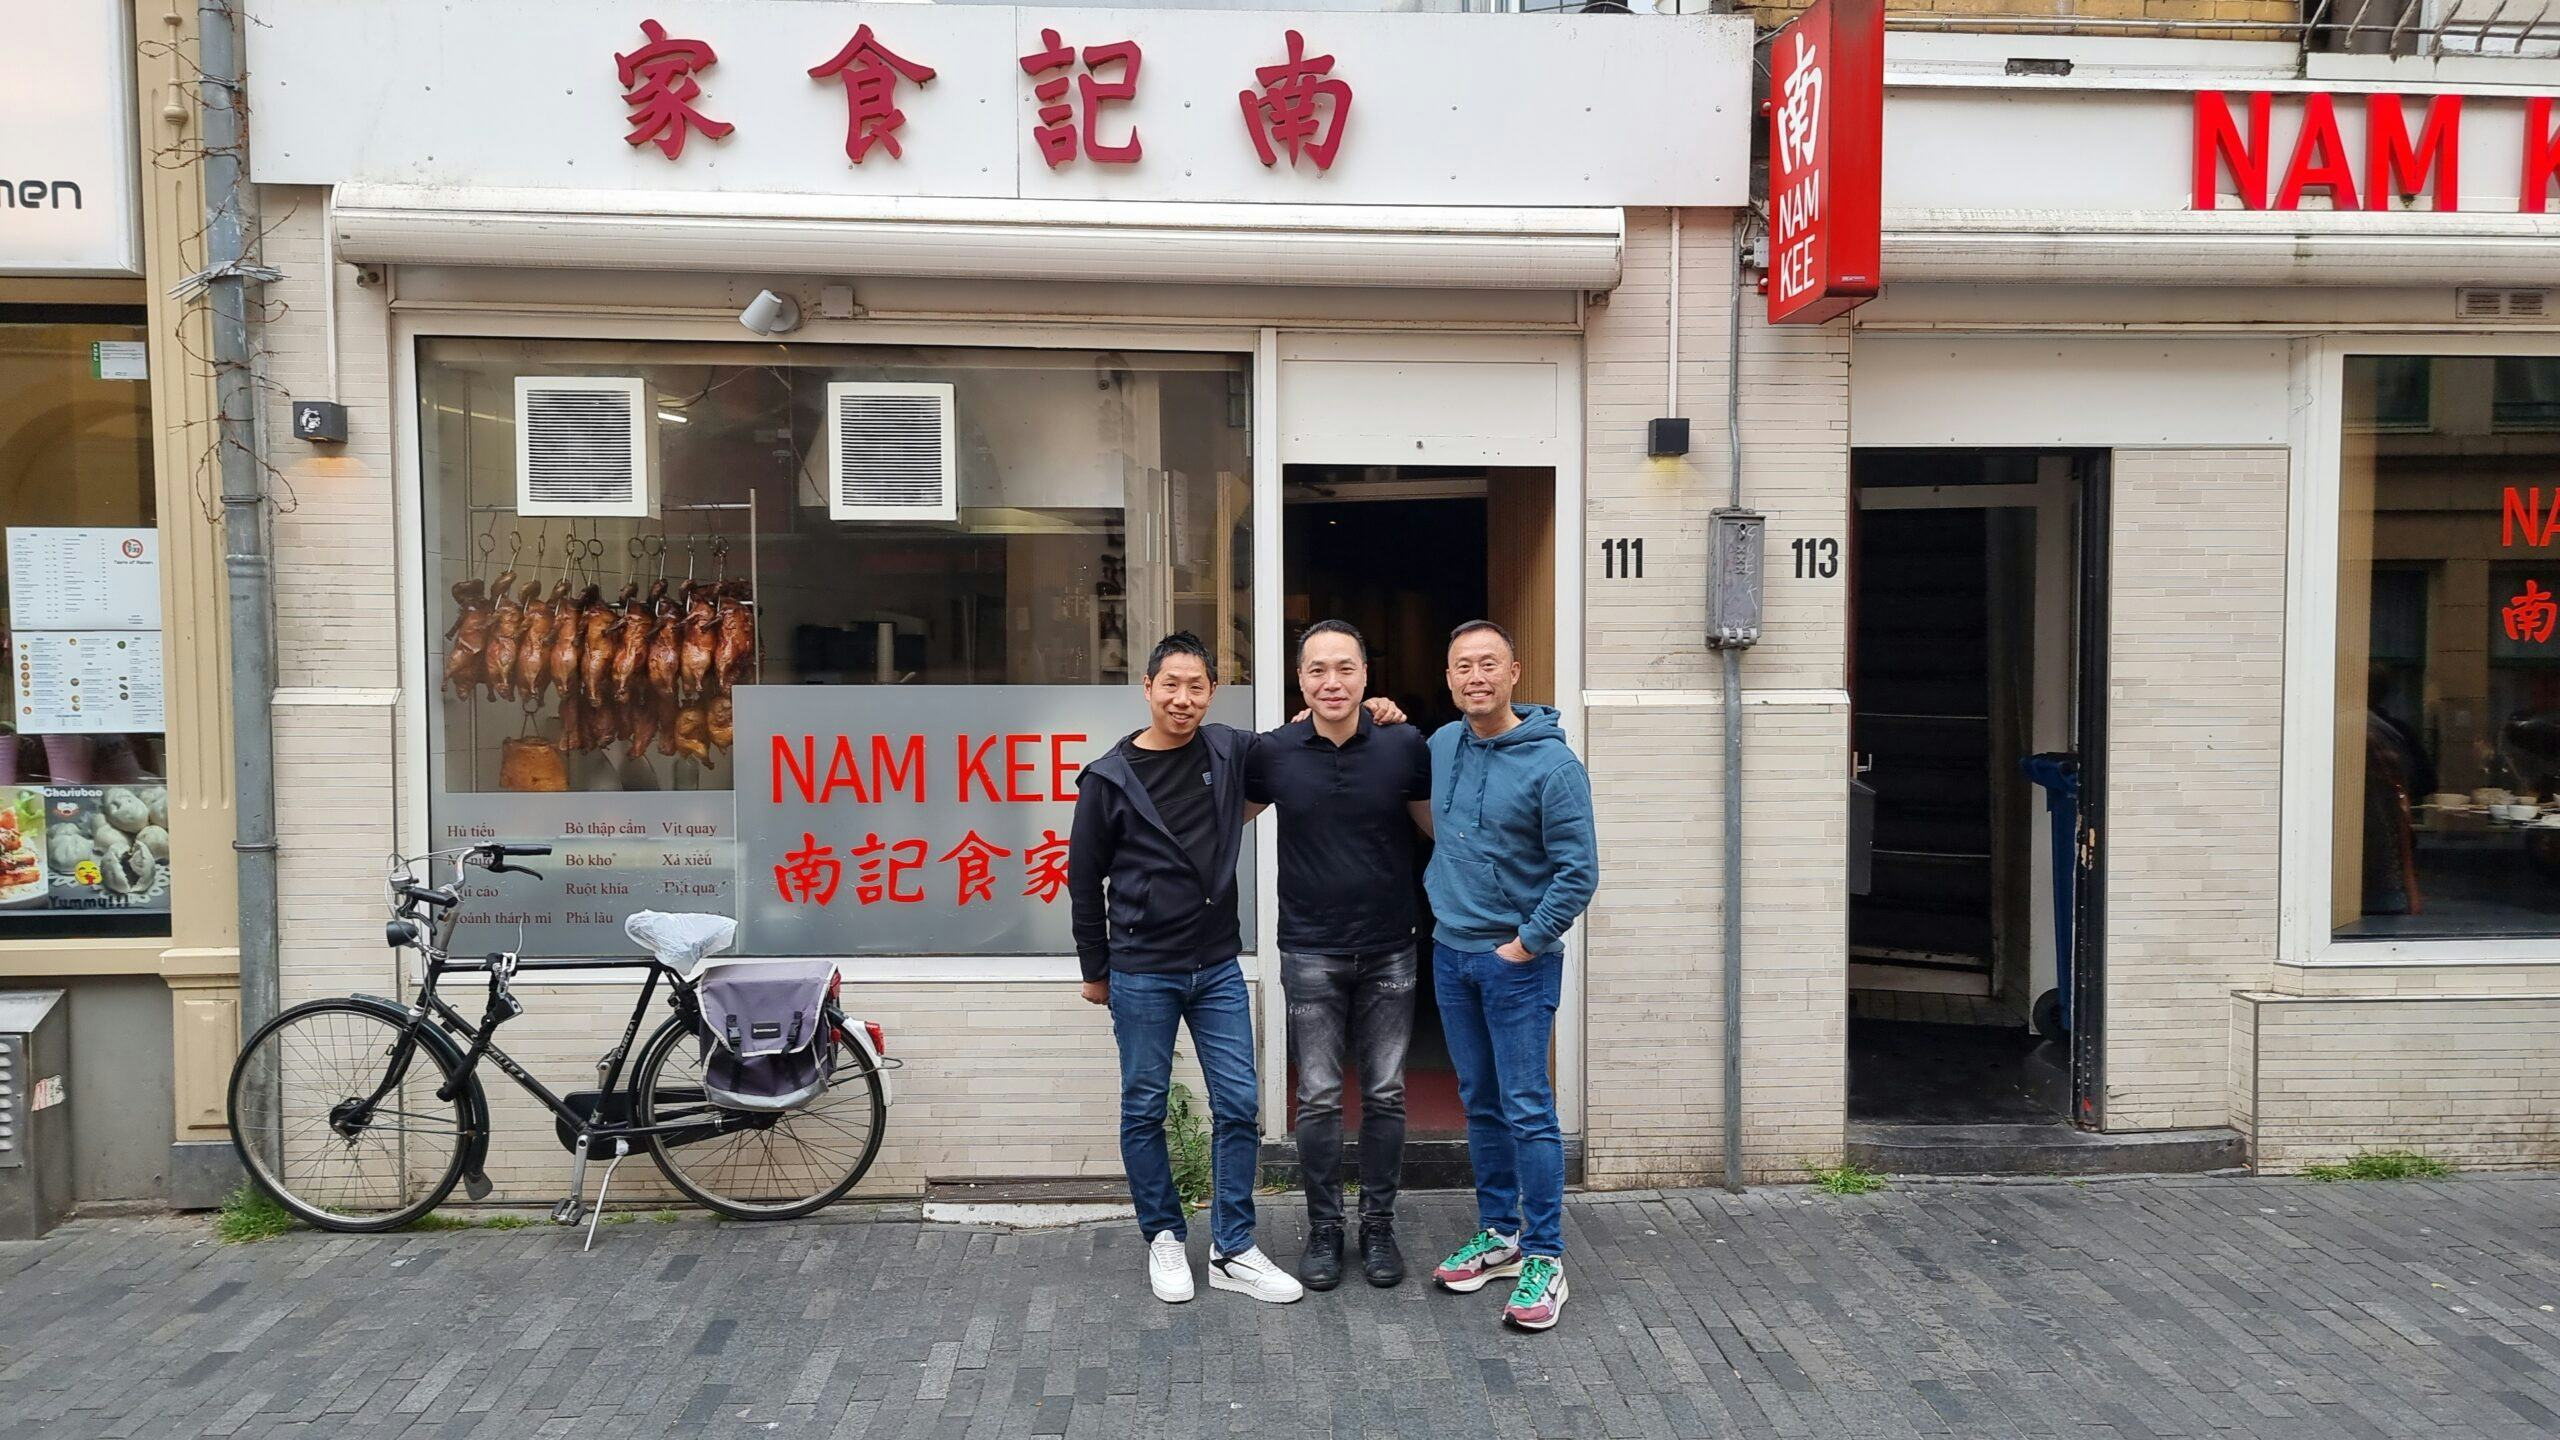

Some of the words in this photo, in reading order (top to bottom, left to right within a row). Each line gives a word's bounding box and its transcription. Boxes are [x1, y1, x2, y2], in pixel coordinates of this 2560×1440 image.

[1777, 32, 1823, 175] 南
[2192, 89, 2464, 213] NAM
[1779, 168, 1820, 245] NAM
[1780, 233, 1816, 302] KEE
[1601, 538, 1643, 579] 111
[1791, 538, 1839, 579] 113
[2502, 579, 2558, 643] 南
[771, 734, 927, 804] NAM
[956, 733, 1088, 804] KEE
[686, 825, 717, 837] quay
